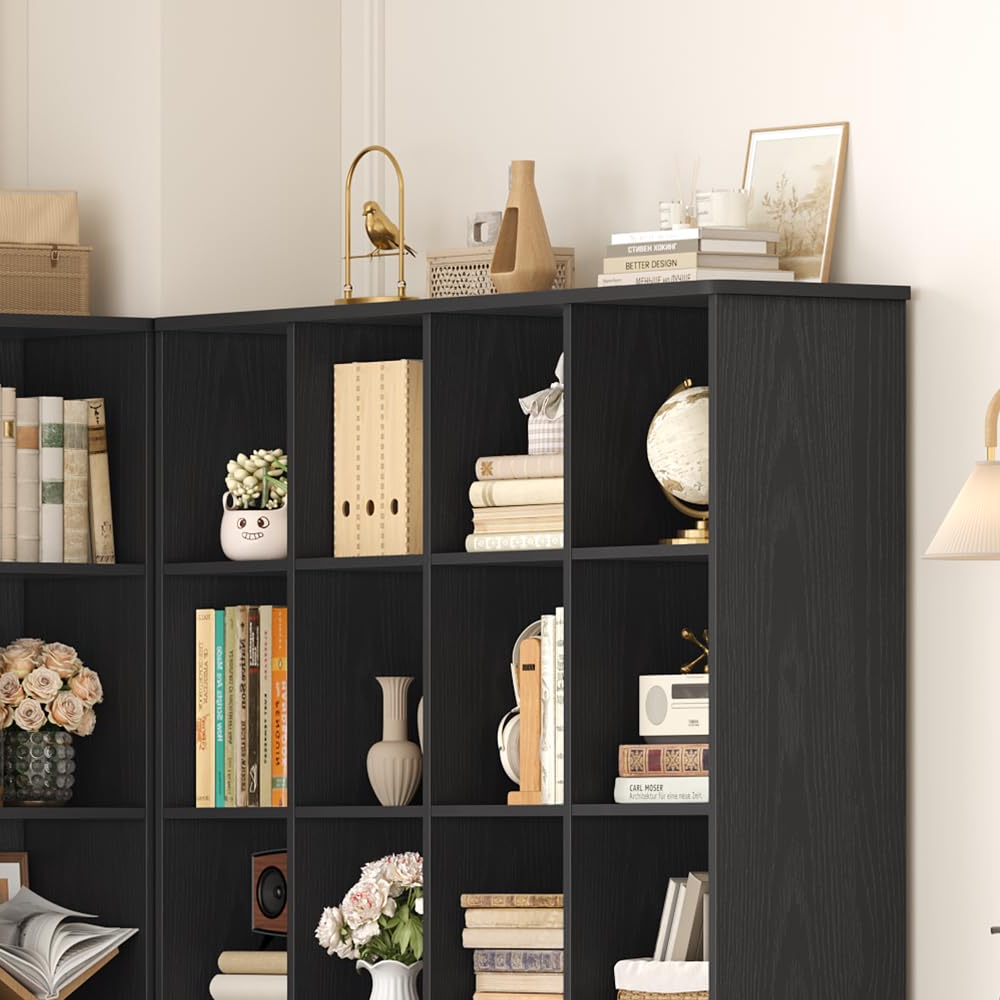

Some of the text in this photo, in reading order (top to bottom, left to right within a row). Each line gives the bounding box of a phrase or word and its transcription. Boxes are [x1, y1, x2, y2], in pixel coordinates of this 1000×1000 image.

[625, 259, 678, 270] BETTER DESIGN
[629, 784, 664, 792] CARL MOSER
